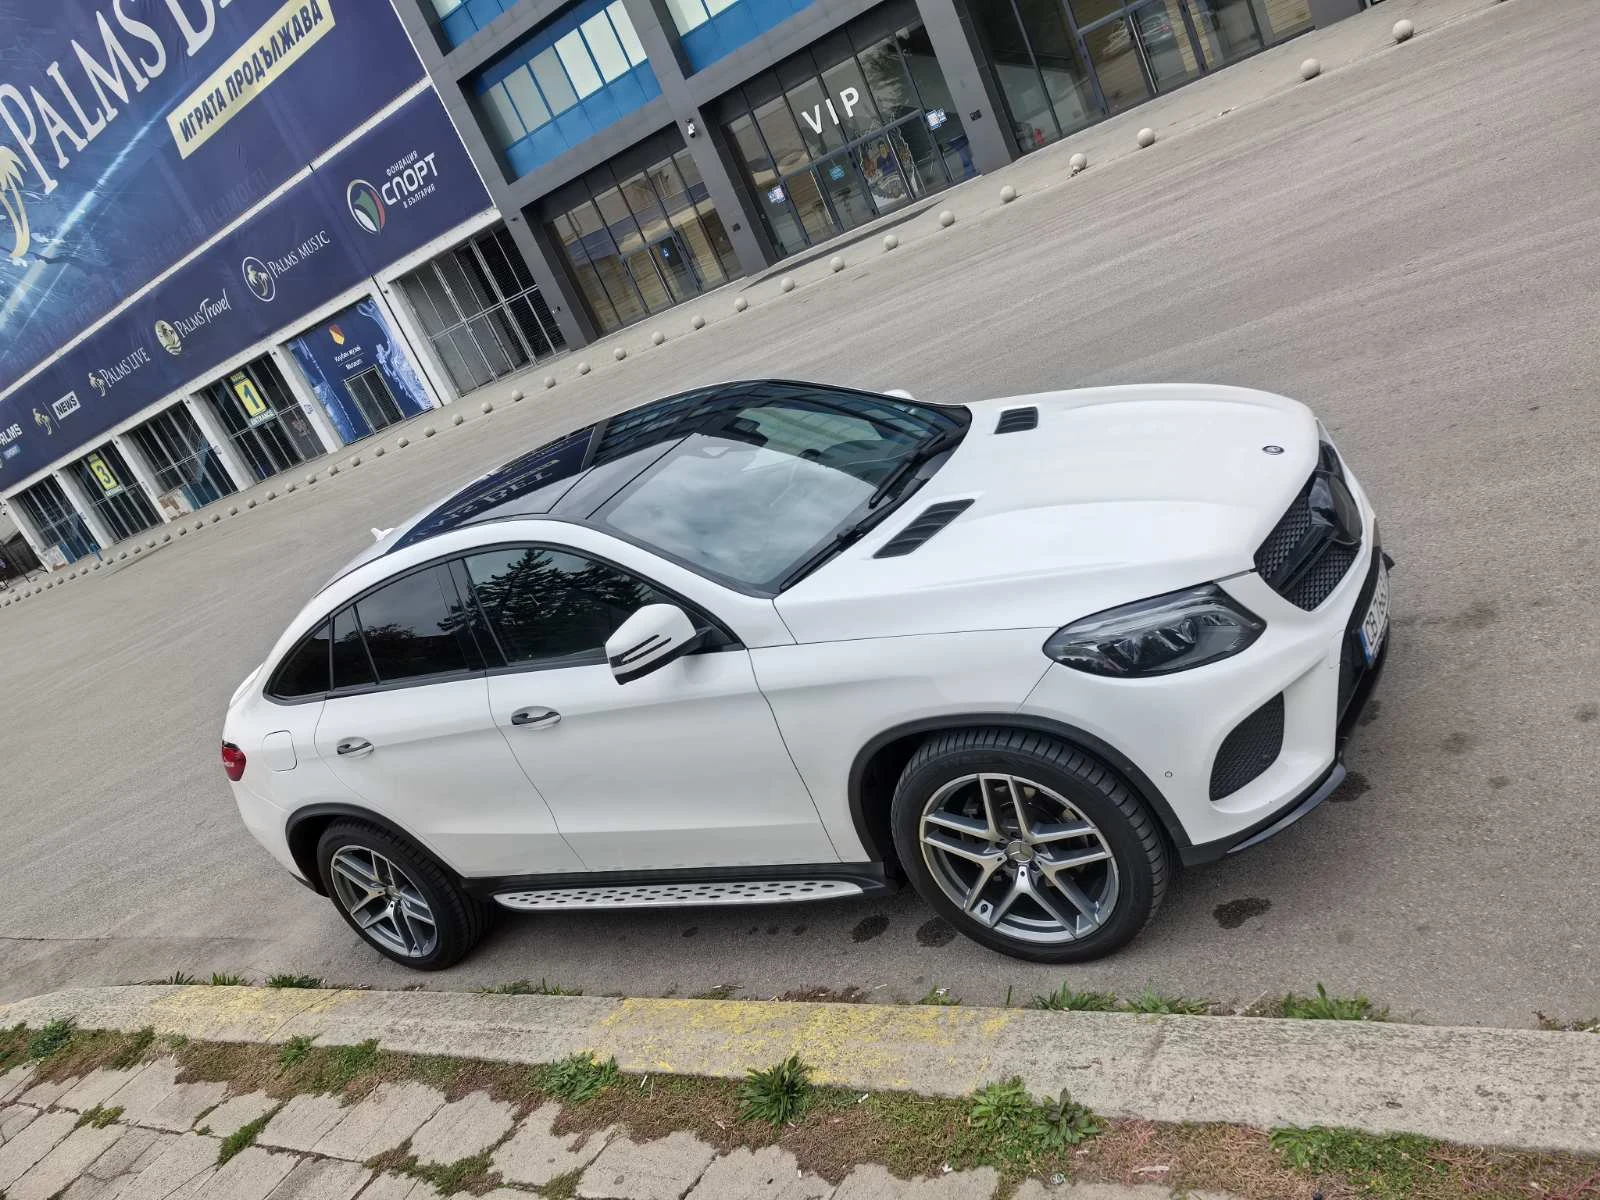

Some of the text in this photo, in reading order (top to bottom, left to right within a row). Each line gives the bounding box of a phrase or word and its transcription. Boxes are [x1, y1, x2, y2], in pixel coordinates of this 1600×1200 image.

[179, 87, 227, 143] ИГРАТА
[225, 0, 324, 102] ПРОДЪЛЖАВА
[0, 0, 167, 195] PALMS
[801, 87, 859, 134] VIP
[381, 152, 438, 206] СПОРТ
[386, 150, 418, 176] ФОНДАЦИЯ
[407, 183, 436, 206] БЪЛГАРИЯ
[267, 230, 330, 278] PALMS MUSIC
[200, 287, 232, 324] Travel
[99, 346, 151, 388] PALMS LIVE
[55, 394, 78, 416] NEWS
[243, 383, 260, 409] 1
[0, 423, 23, 447] ALMS
[96, 465, 111, 484] 3
